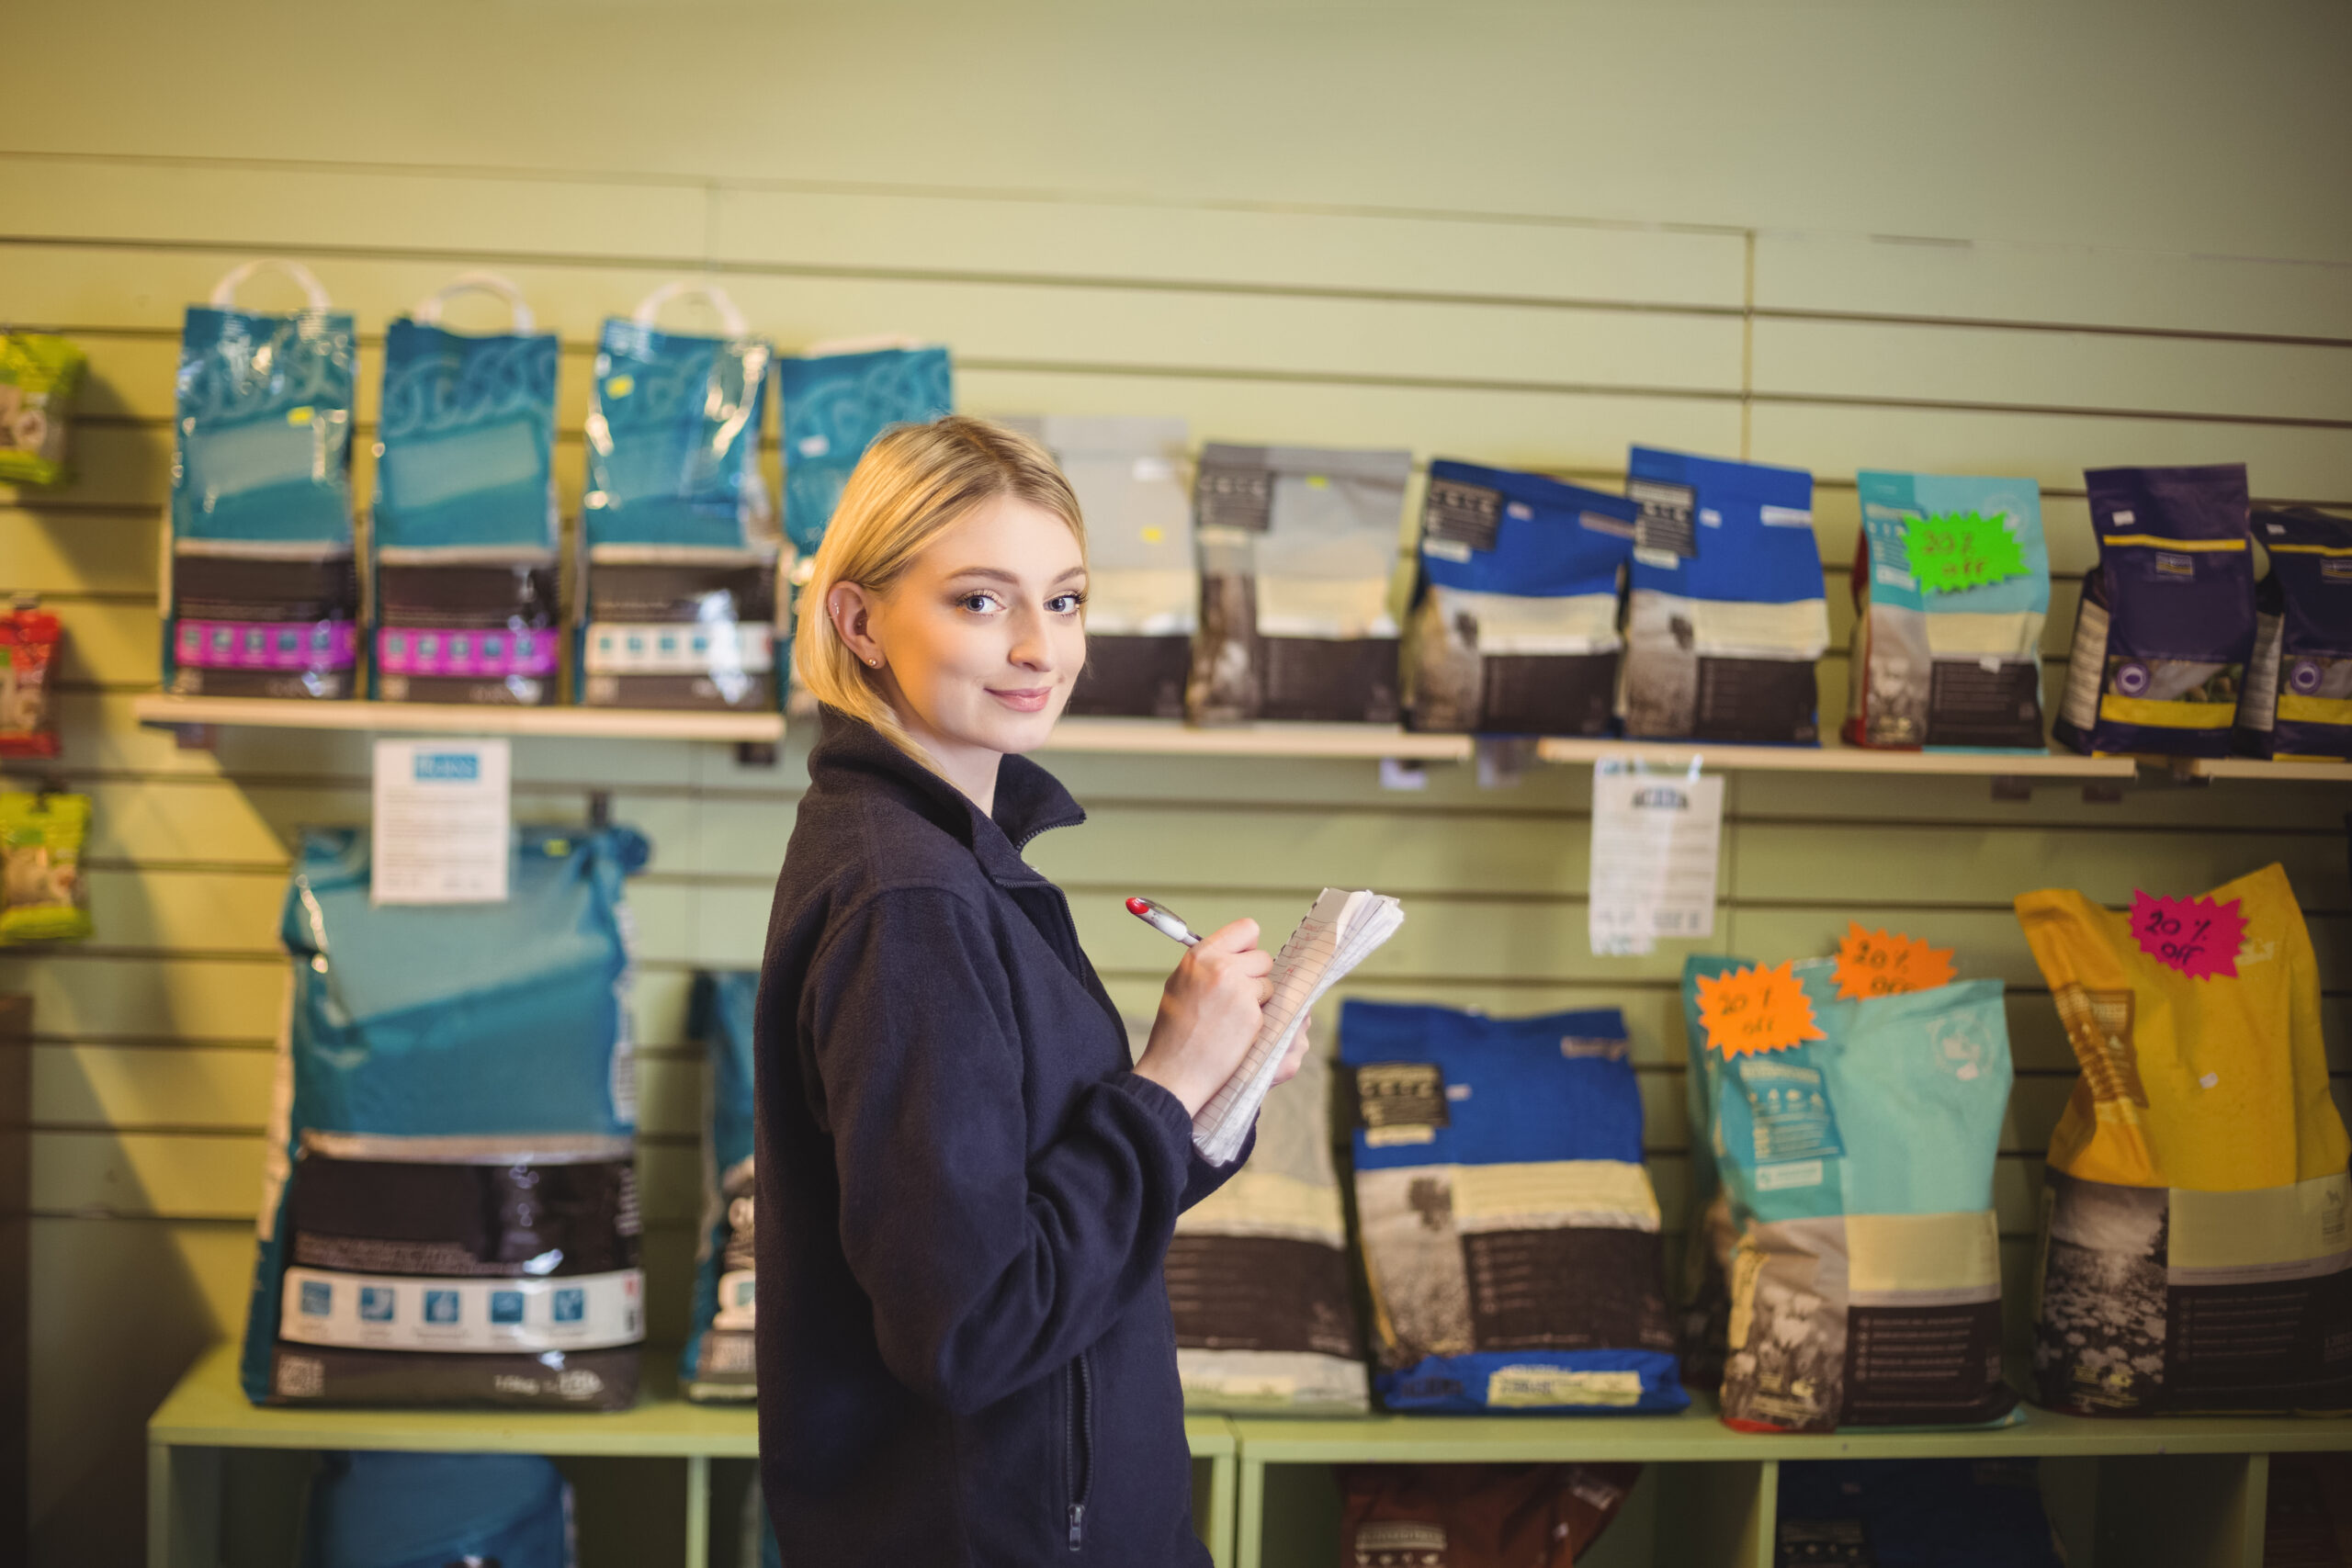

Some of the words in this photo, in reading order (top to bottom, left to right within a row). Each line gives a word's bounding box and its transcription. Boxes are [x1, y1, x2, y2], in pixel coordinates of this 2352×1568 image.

[1921, 530, 1956, 557] 20
[2144, 909, 2181, 936] 20
[2190, 919, 2211, 942] %
[1852, 939, 1888, 970] 20
[1894, 949, 1910, 974] %
[1718, 992, 1749, 1016] 20
